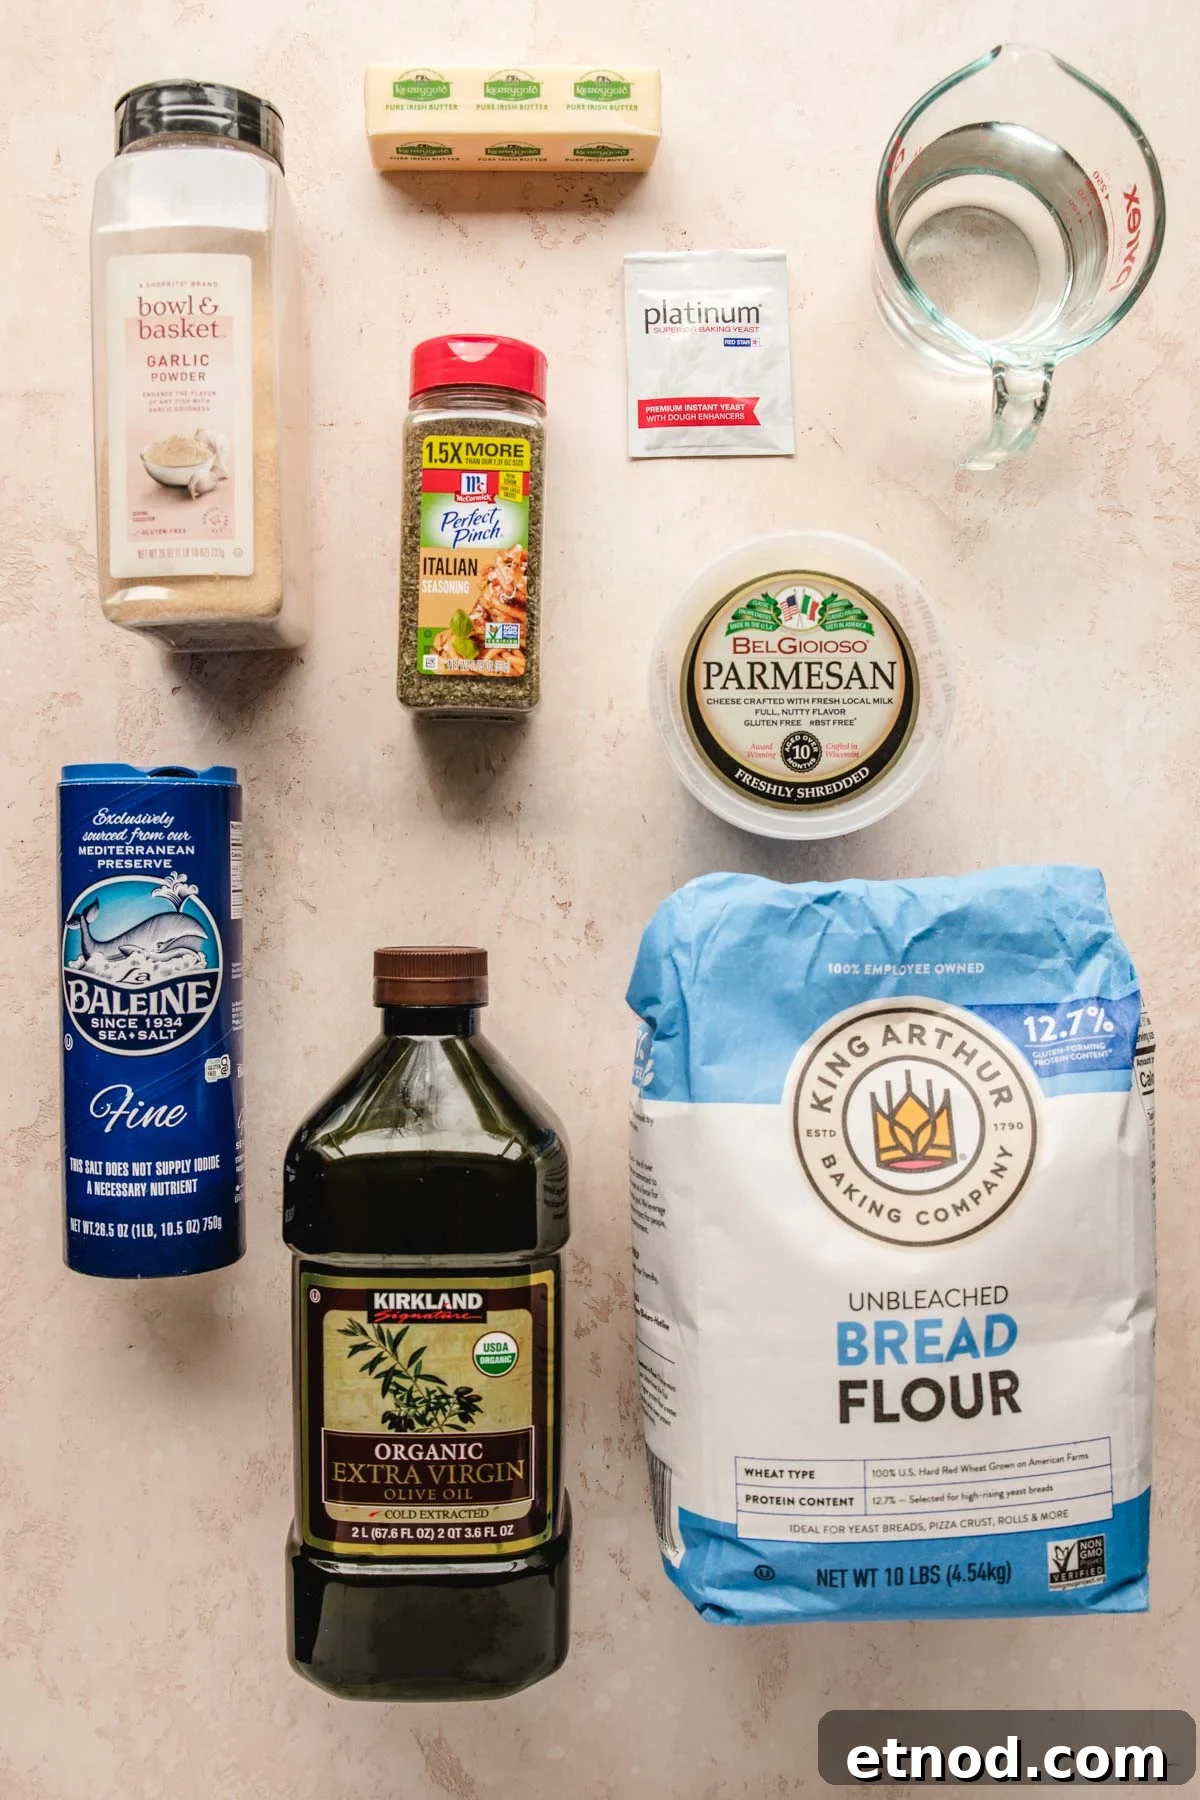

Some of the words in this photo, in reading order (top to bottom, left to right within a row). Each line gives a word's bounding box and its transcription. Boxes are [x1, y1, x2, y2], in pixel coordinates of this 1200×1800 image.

[138, 295, 194, 317] bowl
[199, 297, 219, 315] &
[645, 299, 760, 334] platinum
[138, 318, 219, 340] basket
[147, 354, 209, 367] GARLIC
[151, 372, 206, 382] POWDER
[645, 405, 683, 413] PREMIUM
[719, 403, 745, 411] YEAST
[646, 414, 666, 422] WITH
[667, 413, 696, 421] DOUGH
[698, 412, 745, 420] ENHANCERS
[426, 441, 463, 464] 1.5X
[465, 442, 524, 458] MORE
[456, 493, 492, 502] McCormick
[441, 507, 502, 532] Perfect
[452, 520, 501, 549] Pinch
[423, 557, 478, 576] ITALIAN
[422, 580, 470, 594] SEASONING
[703, 661, 897, 690] PARMESAN
[755, 708, 780, 717] FULL,
[781, 708, 810, 716] NUTTY
[812, 708, 846, 716] FLAVOR
[744, 719, 778, 727] GLUTEN
[779, 719, 802, 727] FREE
[785, 735, 801, 752] AGED
[802, 735, 819, 752] OVER
[792, 744, 811, 760] 10
[786, 757, 817, 769] MONTHS
[734, 768, 794, 798] FRESHLY
[796, 766, 870, 798] SHREDDED
[92, 807, 175, 829] Exclusively
[82, 828, 128, 842] sourced
[125, 827, 165, 845] from
[167, 831, 192, 841] our
[78, 846, 195, 856] MEDITERRANEAN
[97, 859, 172, 869] PRESERVE
[116, 968, 151, 985] La
[827, 963, 860, 975] 100%
[864, 963, 931, 977] EMPLOYEE
[934, 963, 985, 975] OWNED
[67, 979, 212, 1016] BALEINE
[90, 1018, 138, 1029] SINCE
[145, 1017, 183, 1028] 1934
[1023, 1006, 1115, 1043] 12.7%
[98, 1030, 127, 1041] SEA
[137, 1029, 177, 1041] SALT
[1032, 1042, 1106, 1059] GLUTEN-FORMING
[810, 1035, 870, 1113] KING
[881, 1023, 1013, 1108] ARTHUR
[1033, 1056, 1068, 1066] PROTEIN
[89, 1083, 188, 1134] Fine
[806, 1129, 836, 1137] ESTD
[994, 1122, 1024, 1131] 1790
[69, 1157, 84, 1173] THIS
[84, 1159, 103, 1175] SALT
[105, 1161, 129, 1177] DOES
[132, 1162, 152, 1177] NOT
[155, 1159, 192, 1176] SUPPLY
[194, 1155, 220, 1173] IODIDE
[87, 1180, 93, 1195] A
[94, 1181, 147, 1197] NECESSARY
[150, 1178, 198, 1197] NUTRIENT
[821, 1154, 902, 1223] BAKING
[916, 1145, 1013, 1225] COMPANY
[70, 1217, 82, 1233] NET
[117, 1223, 129, 1238] OZ
[131, 1221, 158, 1239] (1LB,
[160, 1221, 183, 1237] 10.5
[186, 1218, 200, 1235] OZ)
[202, 1215, 223, 1231] 750g
[373, 1292, 484, 1310] KIRKLAND
[849, 1285, 1009, 1312] UNBLEACHED
[373, 1309, 483, 1323] Signature
[483, 1342, 509, 1353] USDA
[836, 1313, 1018, 1366] BREAD
[479, 1355, 513, 1365] ORGANIC
[838, 1369, 1022, 1424] FLOUR
[374, 1442, 483, 1461] ORGANIC
[332, 1462, 421, 1484] EXTRA
[427, 1459, 525, 1485] VIRGIN
[744, 1468, 784, 1479] WHEAT
[788, 1470, 815, 1479] TYPE
[872, 1469, 896, 1478] 100%
[898, 1468, 916, 1477] U.S.
[919, 1466, 939, 1476] Hard
[942, 1466, 958, 1475] Red
[960, 1464, 987, 1473] Wheat
[988, 1461, 1015, 1471] Grown
[1028, 1455, 1065, 1466] American
[1067, 1453, 1089, 1462] Farms
[383, 1488, 437, 1501] OLIVE
[443, 1488, 473, 1500] OIL
[745, 1494, 795, 1505] PROTEIN
[798, 1497, 854, 1506] CONTENT
[872, 1496, 896, 1504] 12.7%
[908, 1493, 945, 1504] Selected
[947, 1492, 959, 1501] for
[961, 1489, 1005, 1503] high-rising
[1006, 1487, 1027, 1498] yeast
[1028, 1484, 1053, 1495] breads
[384, 1510, 417, 1520] COLD
[419, 1508, 489, 1520] EXTRACTED
[790, 1524, 820, 1534] IDEAL
[823, 1525, 845, 1534] FOR
[848, 1524, 879, 1534] YEAST
[882, 1522, 926, 1533] BREADS,
[929, 1520, 957, 1531] PIZZA
[959, 1517, 996, 1528] CRUST,
[998, 1514, 1028, 1525] ROLLS
[1031, 1513, 1038, 1522] &
[1040, 1509, 1069, 1520] MORE
[352, 1527, 360, 1538] 2
[362, 1528, 368, 1538] L
[371, 1527, 398, 1541] (67.6
[401, 1528, 413, 1539] FL
[416, 1527, 435, 1541] OZ)
[438, 1527, 445, 1538] 2
[447, 1527, 462, 1540] QT
[464, 1527, 482, 1538] 3.6
[484, 1526, 498, 1538] FL
[499, 1524, 514, 1537] OZ
[1080, 1539, 1102, 1550] NON
[1080, 1548, 1103, 1559] GMO
[816, 1567, 849, 1588] NET
[853, 1567, 880, 1588] WT
[886, 1567, 904, 1586] 10
[910, 1565, 941, 1585] LBS
[946, 1560, 1012, 1587] (4.54kg)
[1053, 1566, 1103, 1581] VERIFIED
